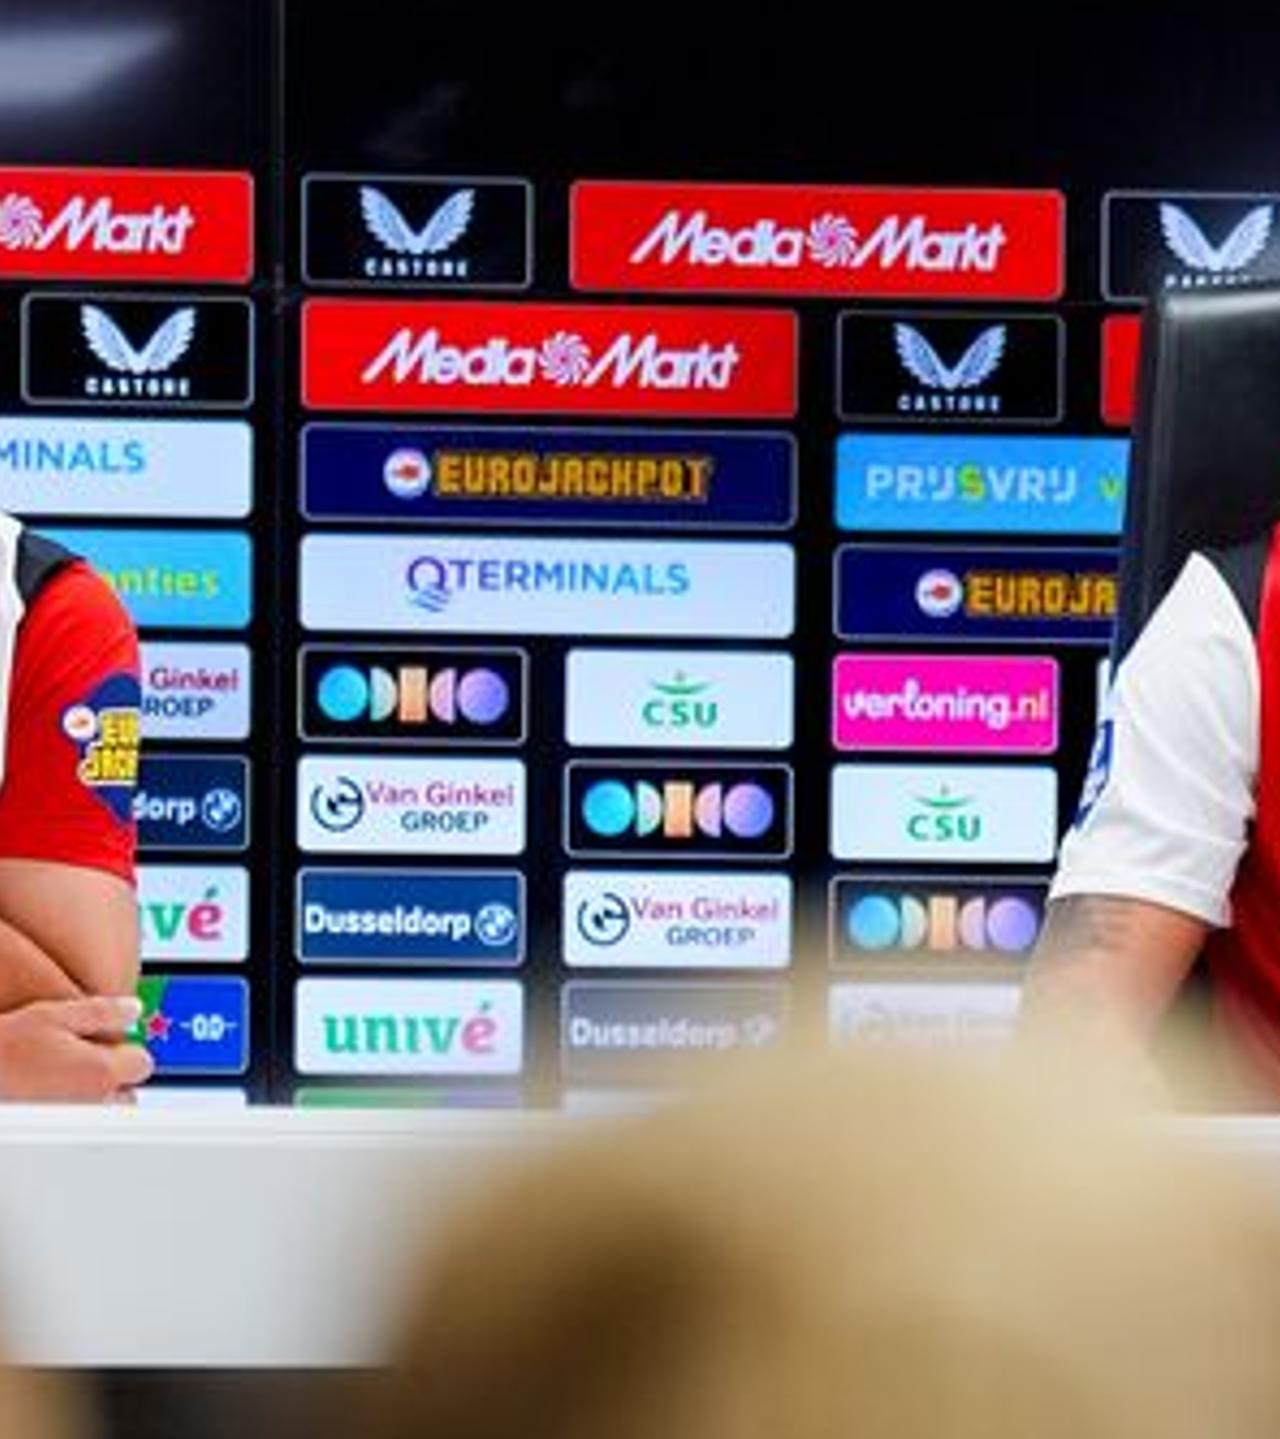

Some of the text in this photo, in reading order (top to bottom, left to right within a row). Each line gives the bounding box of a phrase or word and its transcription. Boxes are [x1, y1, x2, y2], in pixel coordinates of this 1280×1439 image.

[36, 197, 193, 253] Markt
[630, 211, 1006, 272] Media Markt
[362, 327, 739, 389] Media Markt
[85, 378, 190, 396] CASTORE
[436, 452, 712, 500] EUROJACKPOT
[966, 572, 1116, 617] EUROJA
[149, 668, 238, 692] Ginkel
[142, 696, 213, 716] ROEP
[642, 700, 718, 728] CSU
[845, 677, 1048, 729] verloning.nl
[365, 782, 513, 807] Van Ginkel
[401, 811, 489, 833] GROEP
[907, 815, 980, 841] CSU
[305, 904, 470, 942] Dusseldorp
[633, 897, 778, 922] Van Ginkel
[665, 926, 755, 948] GROEP
[323, 1002, 499, 1055] univé
